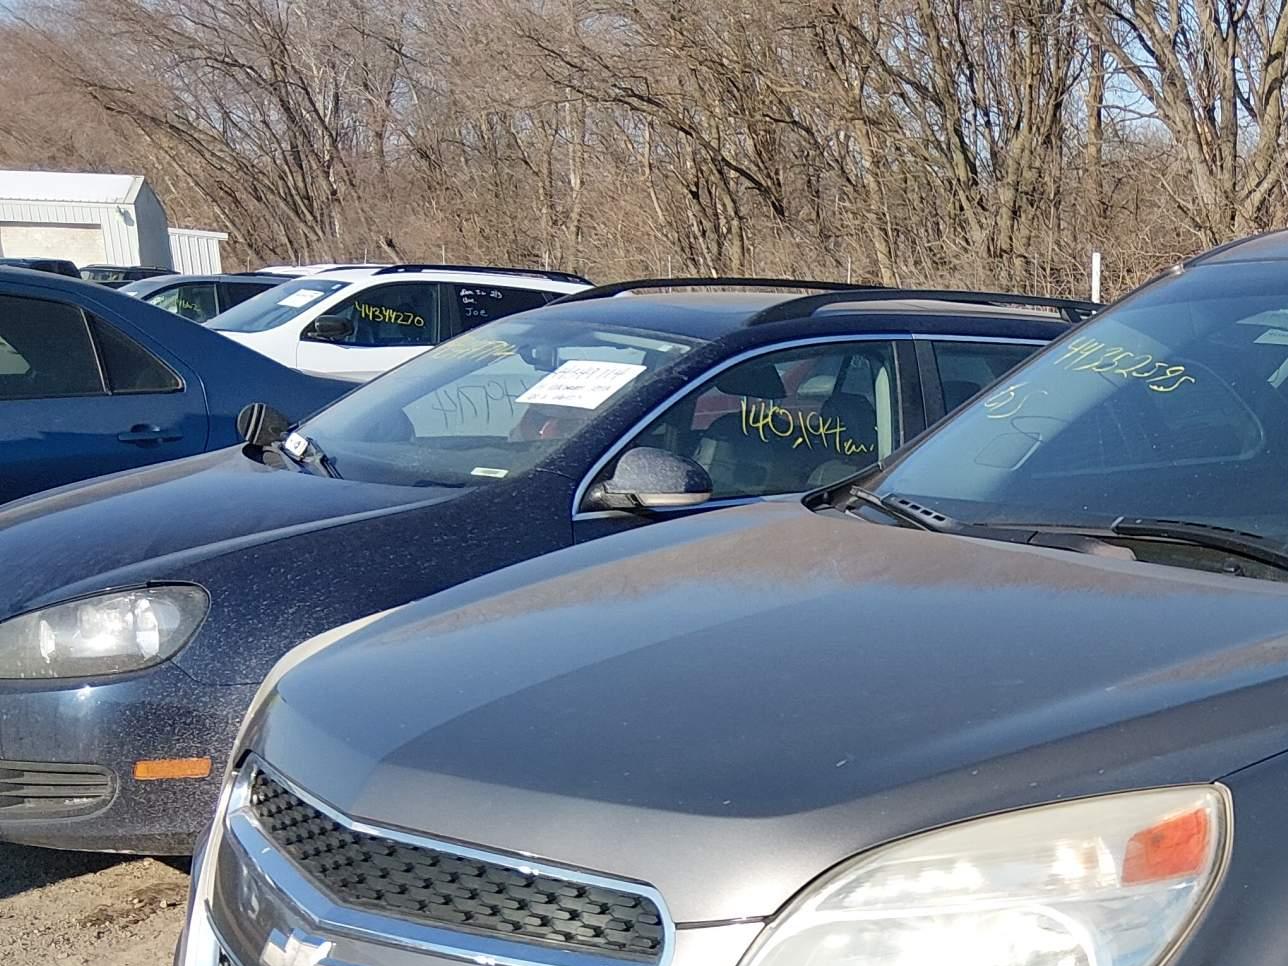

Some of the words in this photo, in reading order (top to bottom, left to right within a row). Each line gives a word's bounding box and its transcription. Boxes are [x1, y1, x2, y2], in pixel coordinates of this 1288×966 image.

[354, 301, 425, 328] 44344270
[465, 307, 489, 317] Joe
[1054, 336, 1196, 392] 44352595
[740, 396, 847, 453] 140,194
